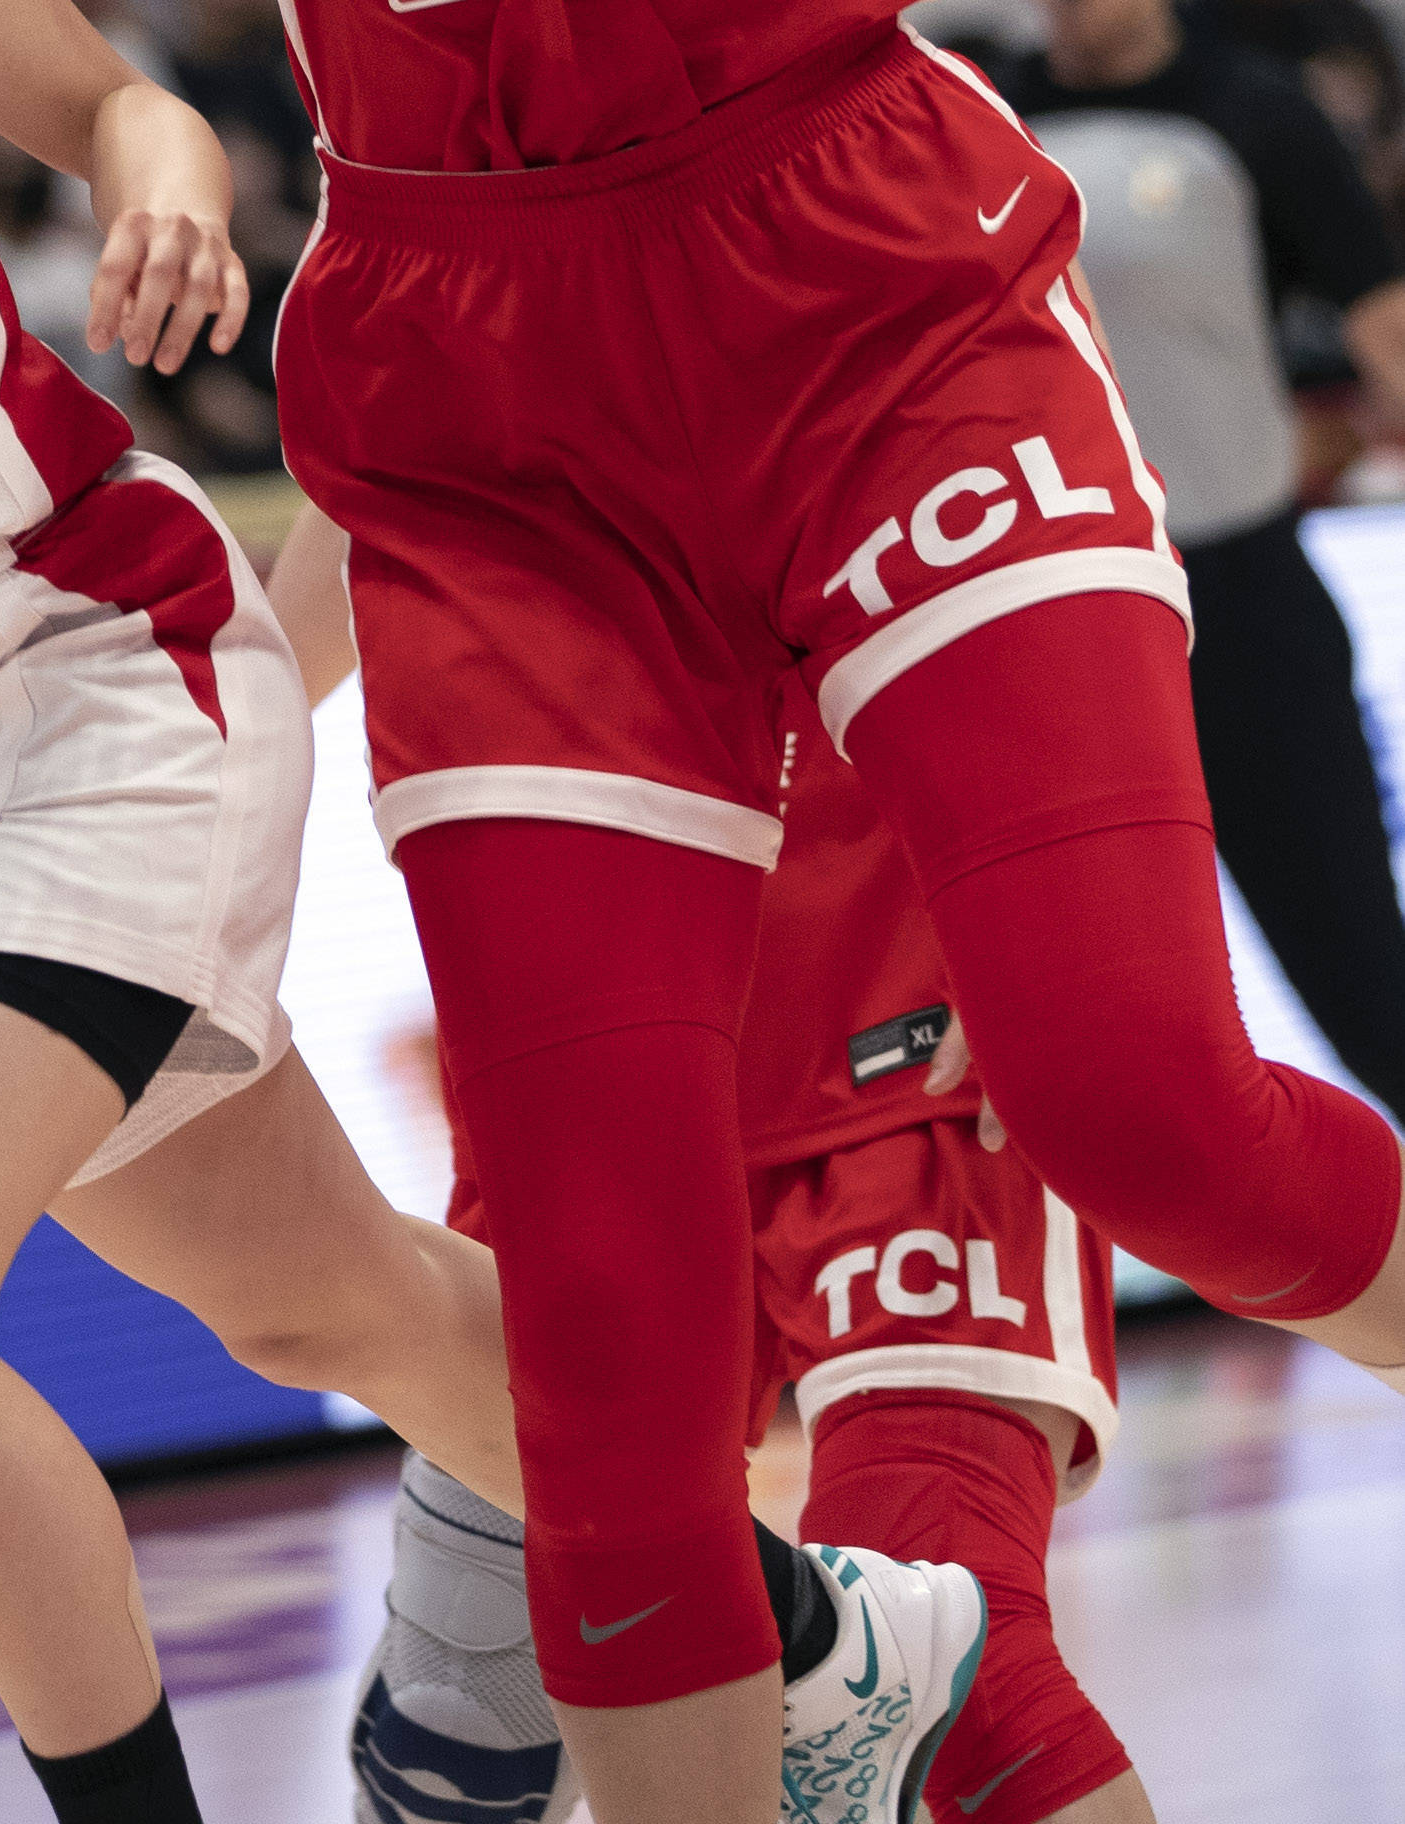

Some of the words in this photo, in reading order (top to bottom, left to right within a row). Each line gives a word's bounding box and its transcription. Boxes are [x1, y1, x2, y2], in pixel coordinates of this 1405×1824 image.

[822, 435, 1116, 617] TCL
[909, 1023, 941, 1050] XL
[814, 1228, 1027, 1339] TCL
